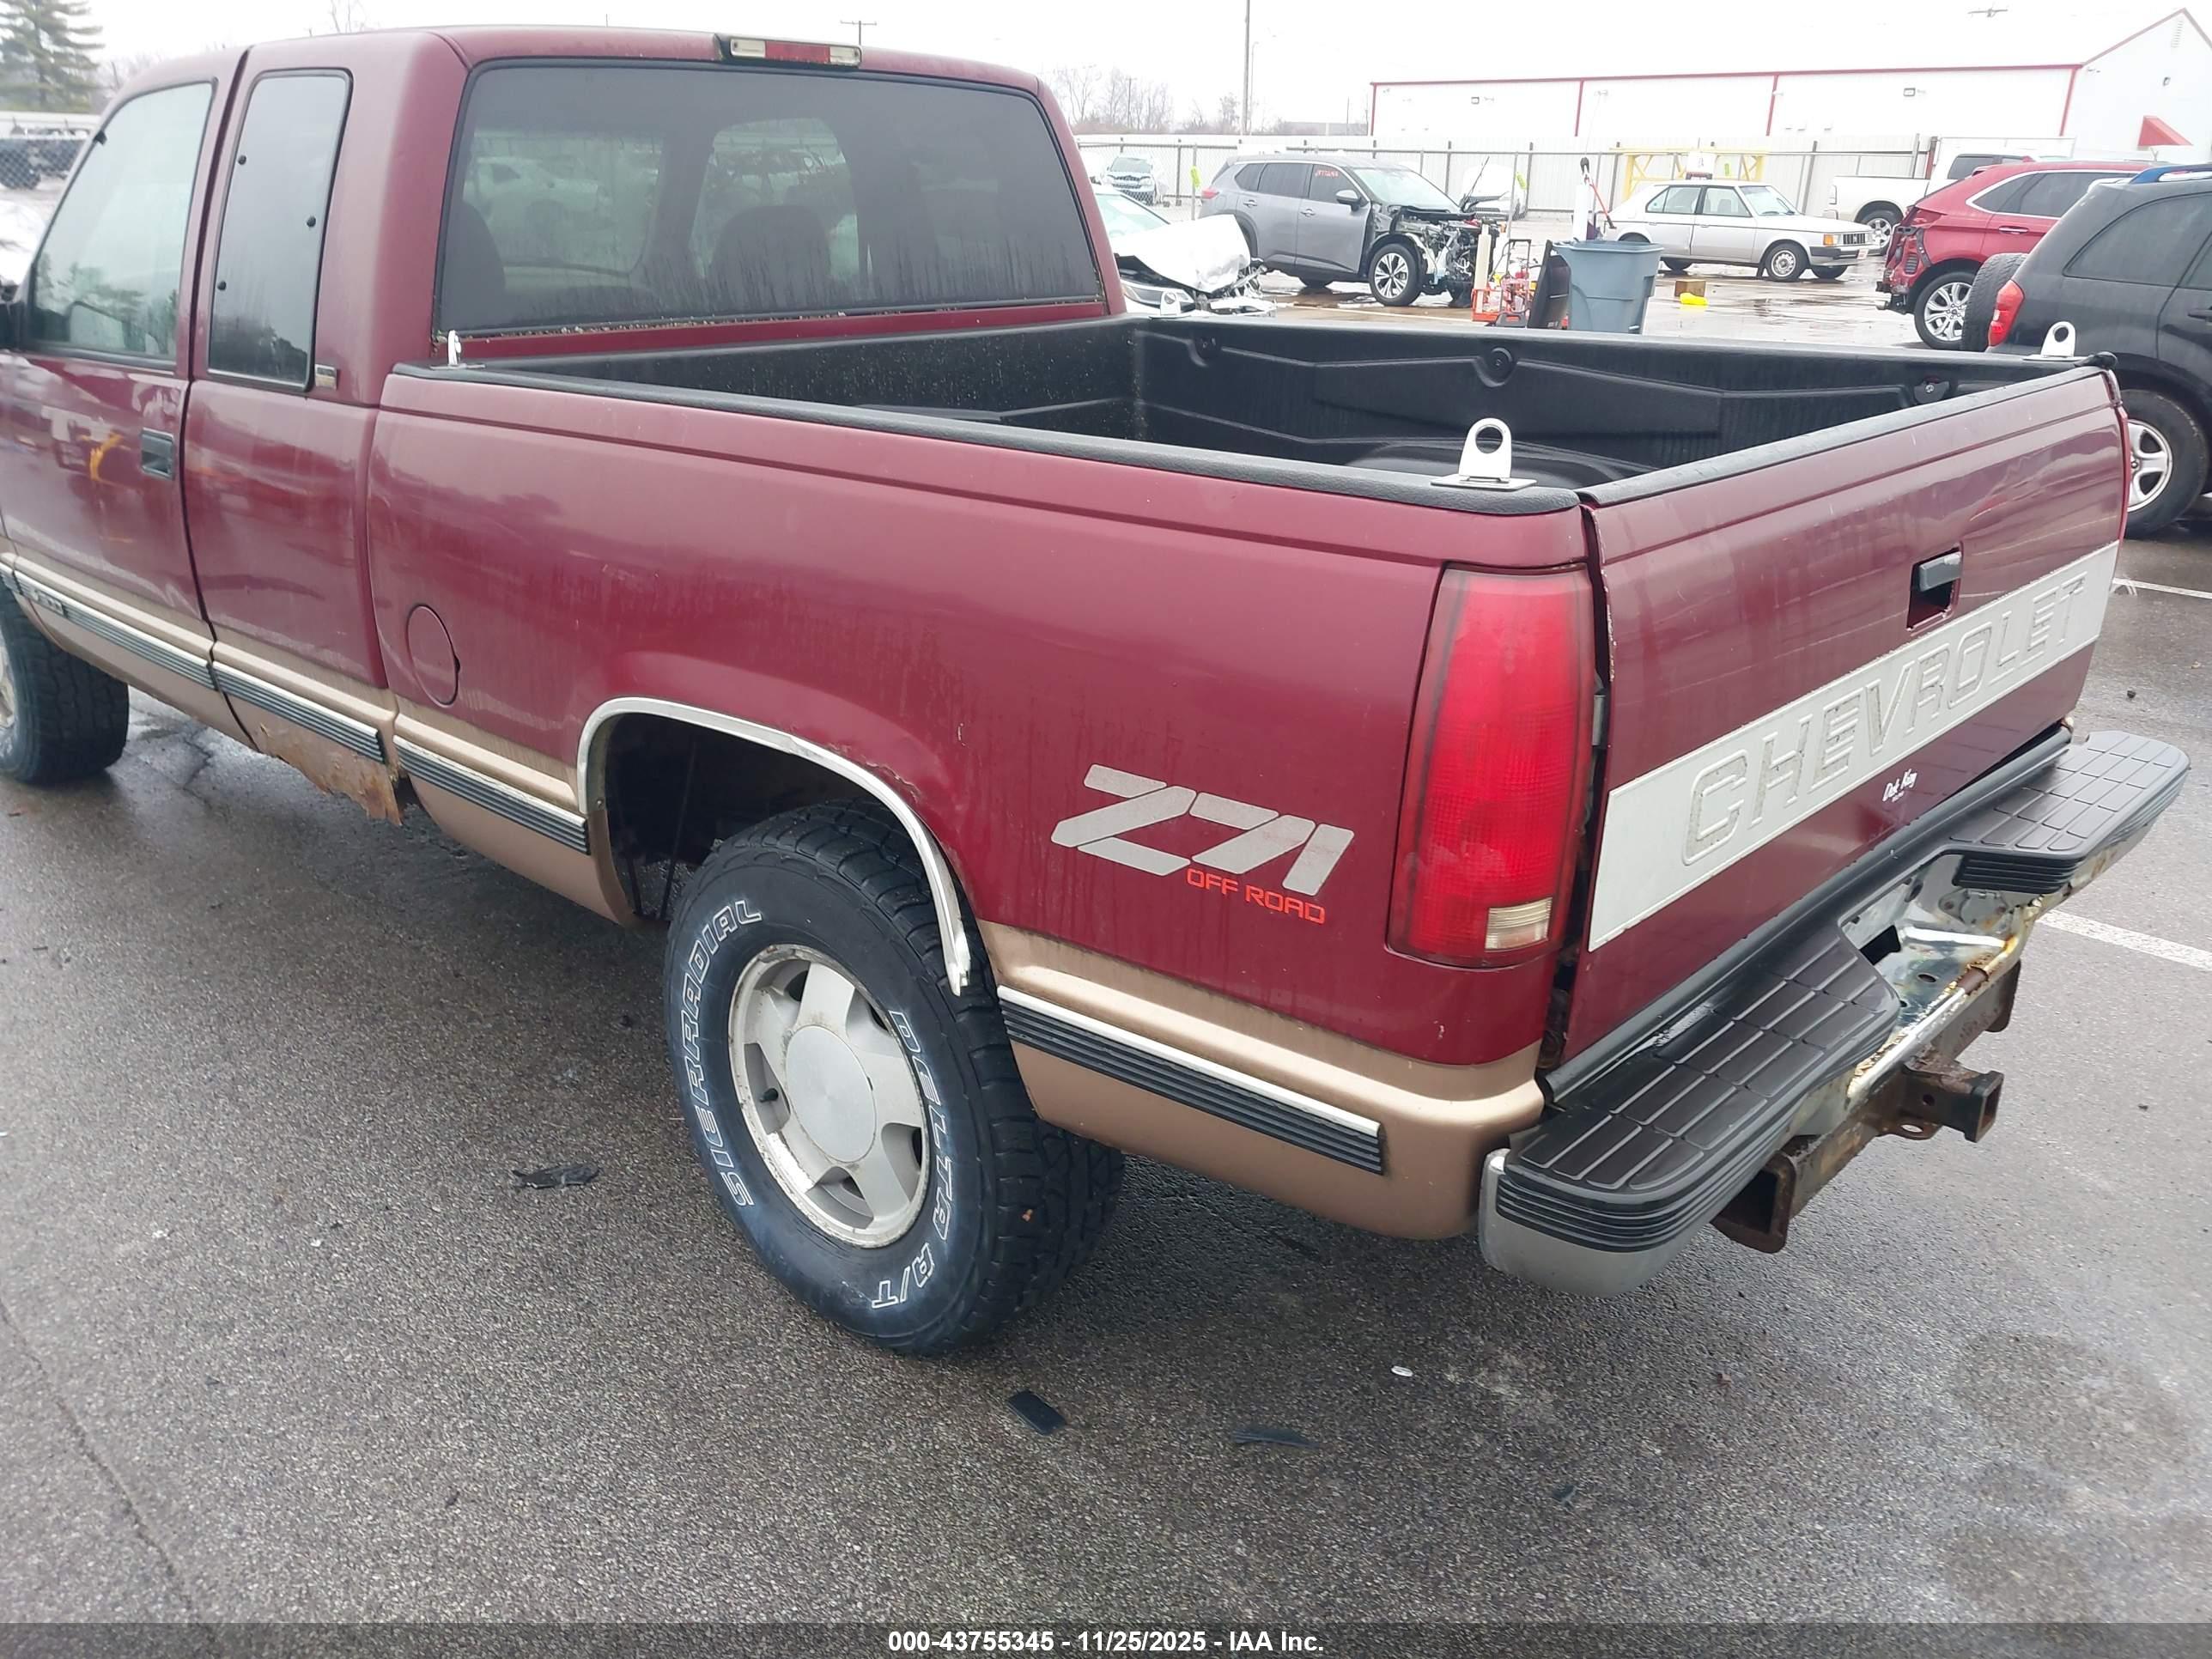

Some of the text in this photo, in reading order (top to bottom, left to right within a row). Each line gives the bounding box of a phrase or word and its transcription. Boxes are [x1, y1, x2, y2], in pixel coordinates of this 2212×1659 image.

[1684, 570, 2087, 866] CHEVROLET
[1051, 763, 1355, 896] Z71
[1186, 867, 1326, 925] OFF ROAD
[888, 1010, 955, 1241] DELTA
[871, 1243, 936, 1310] A/T
